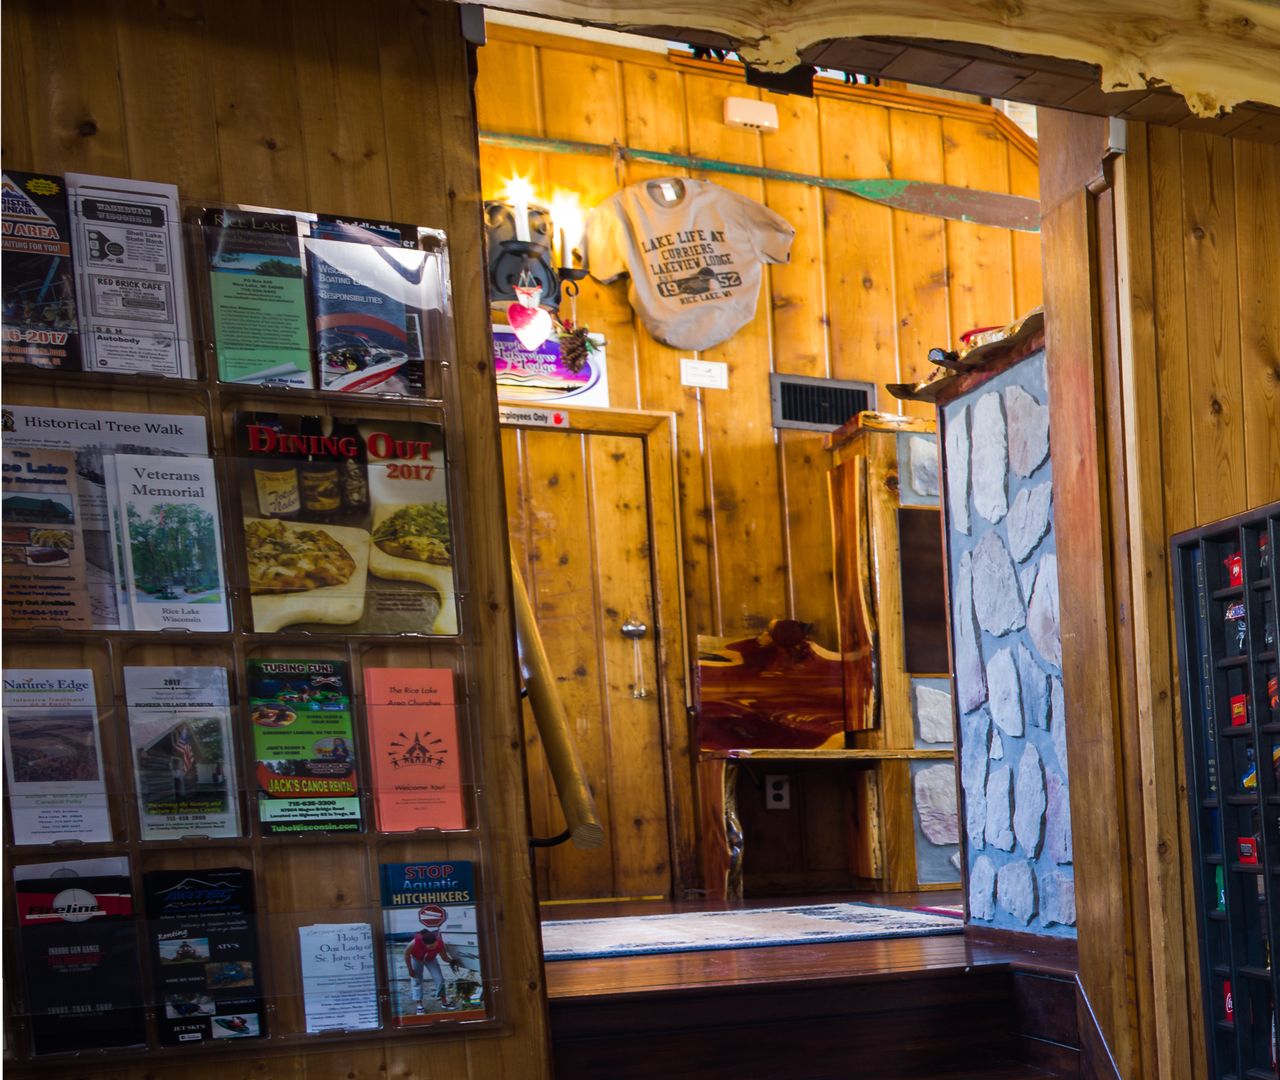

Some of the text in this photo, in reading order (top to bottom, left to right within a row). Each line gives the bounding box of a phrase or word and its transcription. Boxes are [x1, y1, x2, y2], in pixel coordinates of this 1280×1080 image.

[15, 223, 60, 240] AREA
[145, 231, 163, 239] Lake
[641, 229, 726, 254] LAKE LIFE AT
[661, 243, 715, 261] CURRIERS
[650, 253, 735, 276] LAKEVIEW LODGE
[97, 278, 164, 292] RED BRICK CAFE
[659, 271, 740, 297] 19 52
[679, 295, 699, 305] RICE
[723, 290, 733, 298] WI
[97, 335, 140, 345] Autobody
[533, 412, 549, 424] Only
[24, 416, 184, 436] Historical Tree Walk
[26, 462, 69, 476] Lake
[133, 467, 201, 482] Veterans
[387, 463, 436, 482] 2017
[132, 484, 206, 499] Memorial
[162, 616, 201, 624] Wisconsin
[261, 662, 334, 674] TUBING FUN!
[3, 679, 89, 693] Nature's Edge
[163, 679, 181, 687] 2017
[388, 686, 402, 694] The
[387, 698, 441, 706] Area Churches
[268, 778, 356, 793] JACK'S CANOE RENTAL
[271, 823, 358, 833] TubeWisconsin.com
[404, 864, 455, 881] STOP
[402, 879, 460, 894] Aquatic
[392, 889, 471, 906] HITCHHIKERS
[29, 903, 102, 915] Fireline
[157, 929, 189, 941] Renting
[337, 933, 359, 943] Holy
[342, 943, 364, 952] Lady
[332, 954, 351, 963] John
